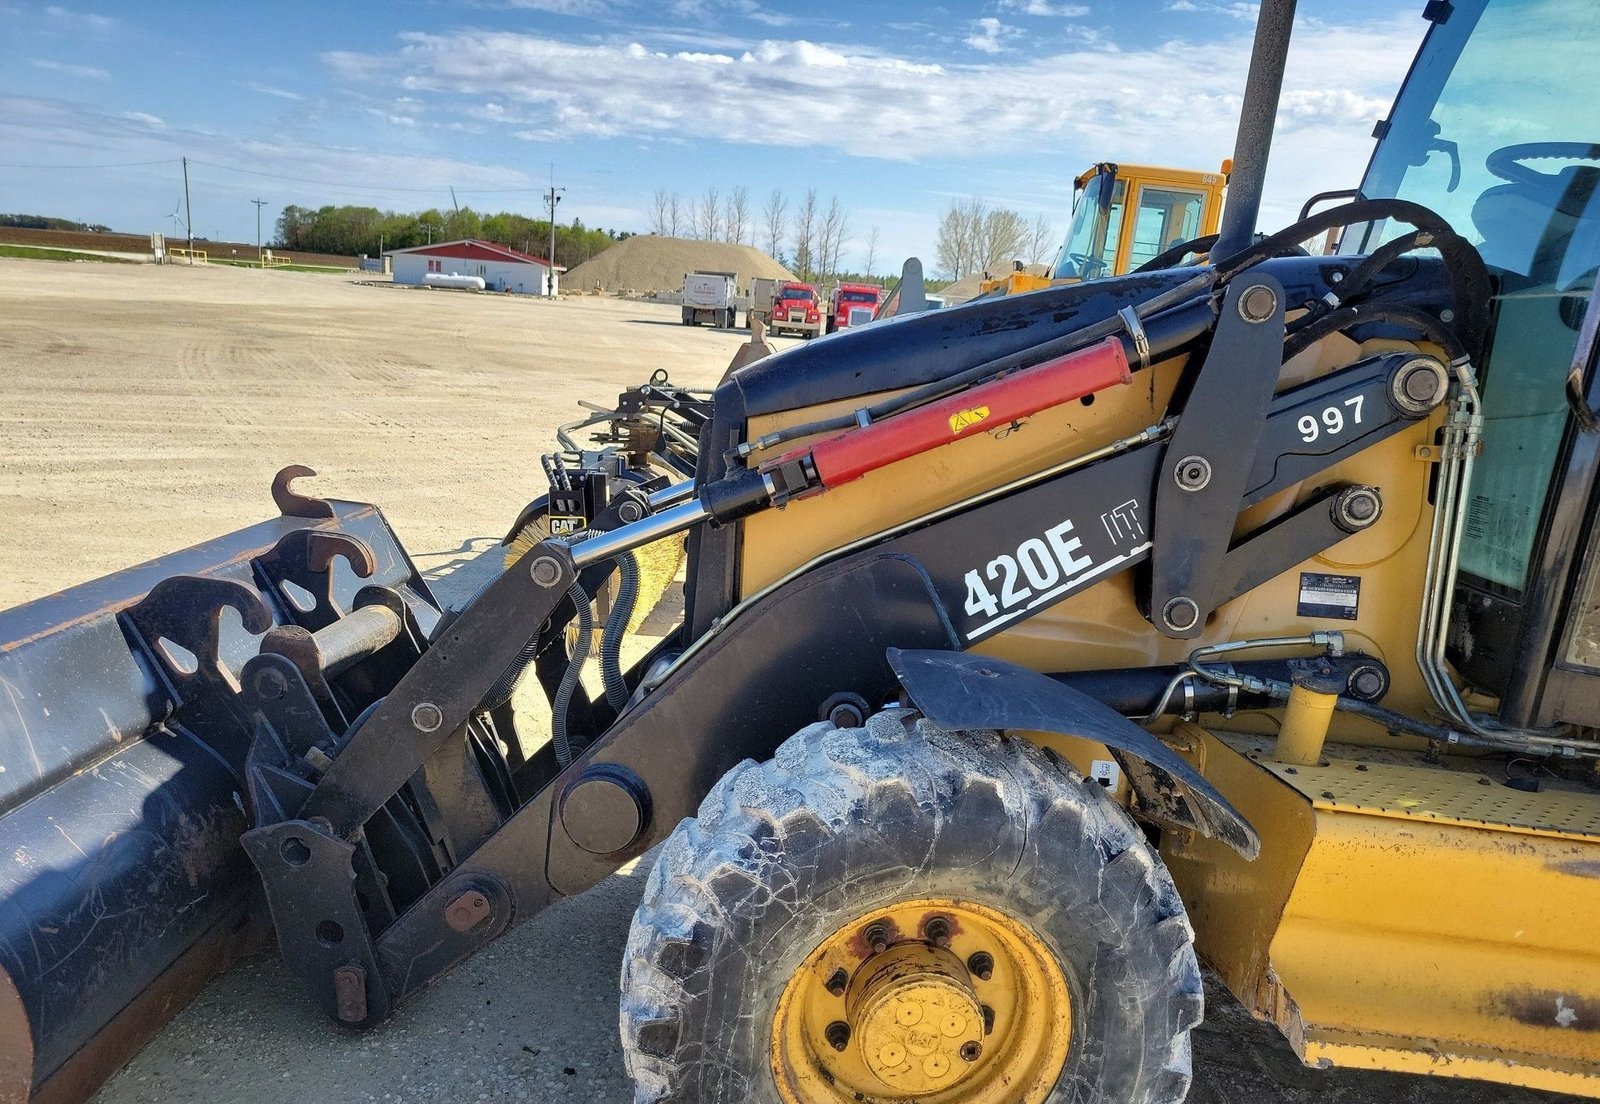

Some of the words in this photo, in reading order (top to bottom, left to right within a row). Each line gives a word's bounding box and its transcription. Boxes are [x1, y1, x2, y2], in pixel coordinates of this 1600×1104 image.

[1297, 394, 1364, 443] 997
[551, 519, 578, 534] CAT
[964, 518, 1093, 618] 420E
